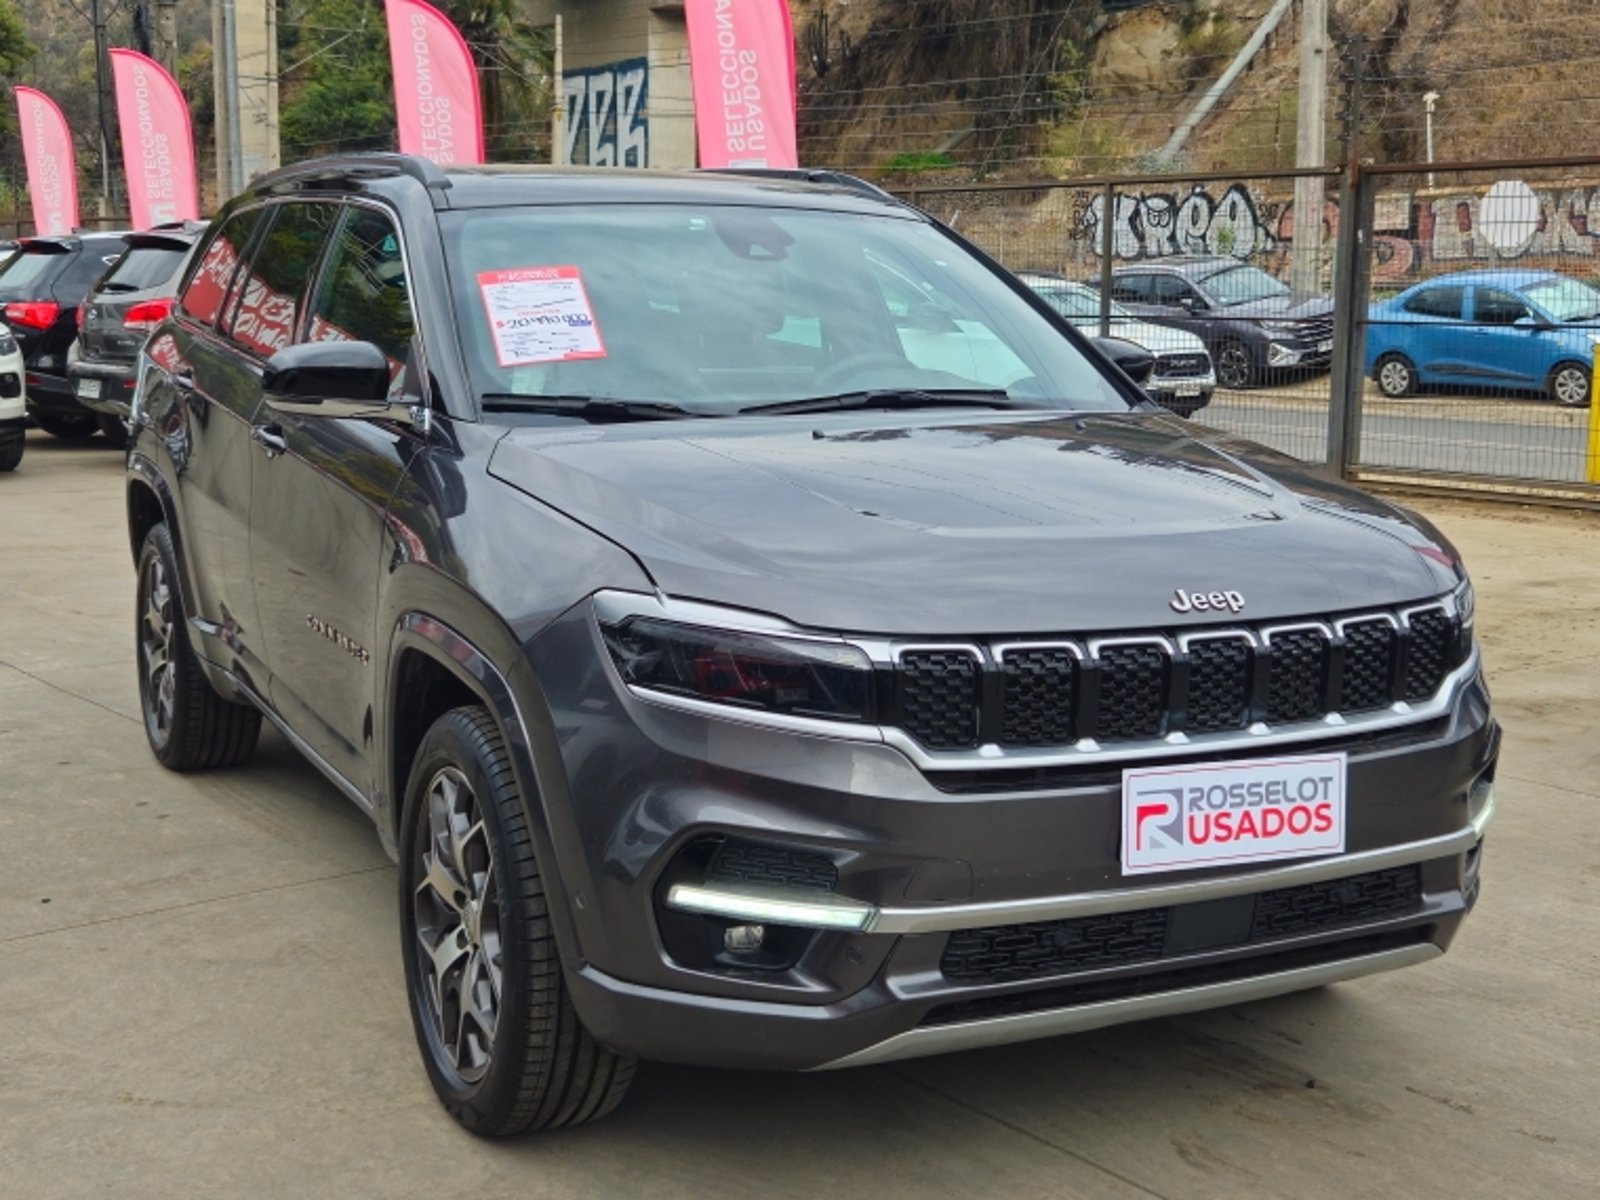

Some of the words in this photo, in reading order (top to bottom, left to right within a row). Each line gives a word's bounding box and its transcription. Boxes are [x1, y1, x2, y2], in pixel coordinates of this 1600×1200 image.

[1169, 588, 1246, 613] Jeep
[1188, 776, 1333, 812] ROSSELOT
[1187, 803, 1333, 845] USADOS
